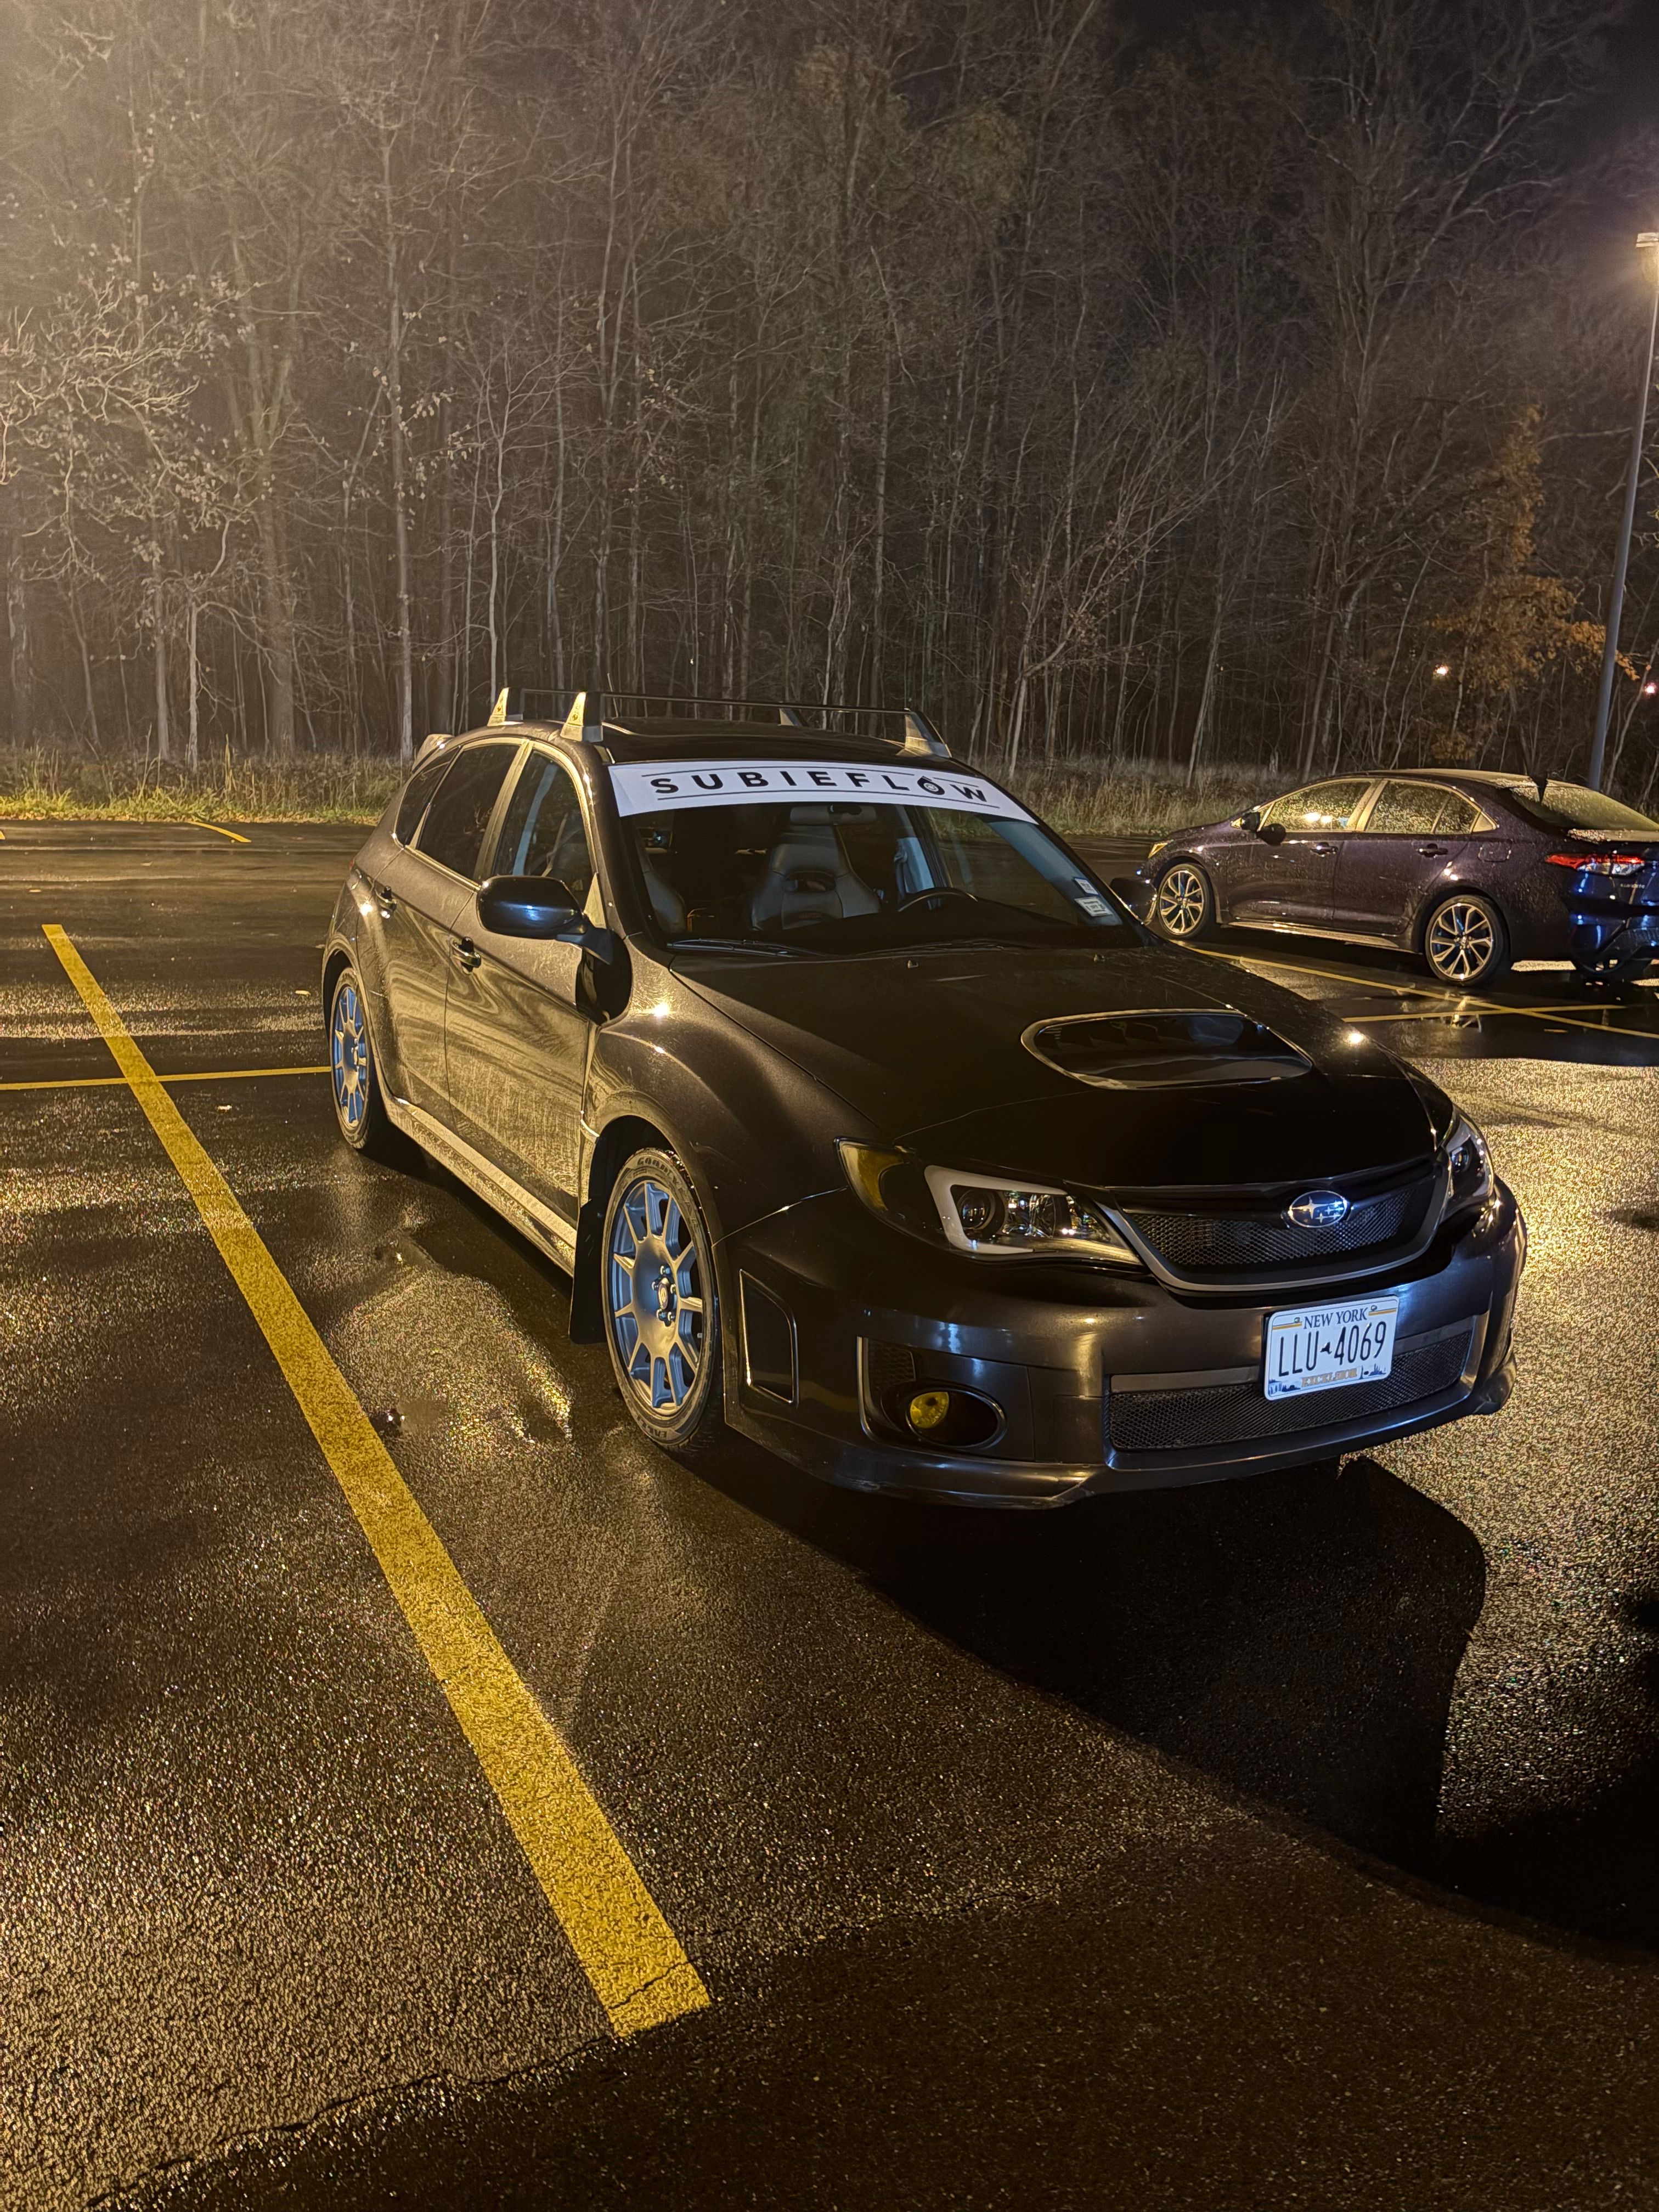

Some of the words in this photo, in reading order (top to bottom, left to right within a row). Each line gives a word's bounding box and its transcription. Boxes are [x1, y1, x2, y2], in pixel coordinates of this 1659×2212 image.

[651, 771, 987, 802] SUBIEFLOW
[1304, 1312, 1333, 1329] NEW
[1335, 1307, 1369, 1324] YORK
[1279, 1330, 1319, 1376] LLU
[1334, 1321, 1387, 1365] 4069
